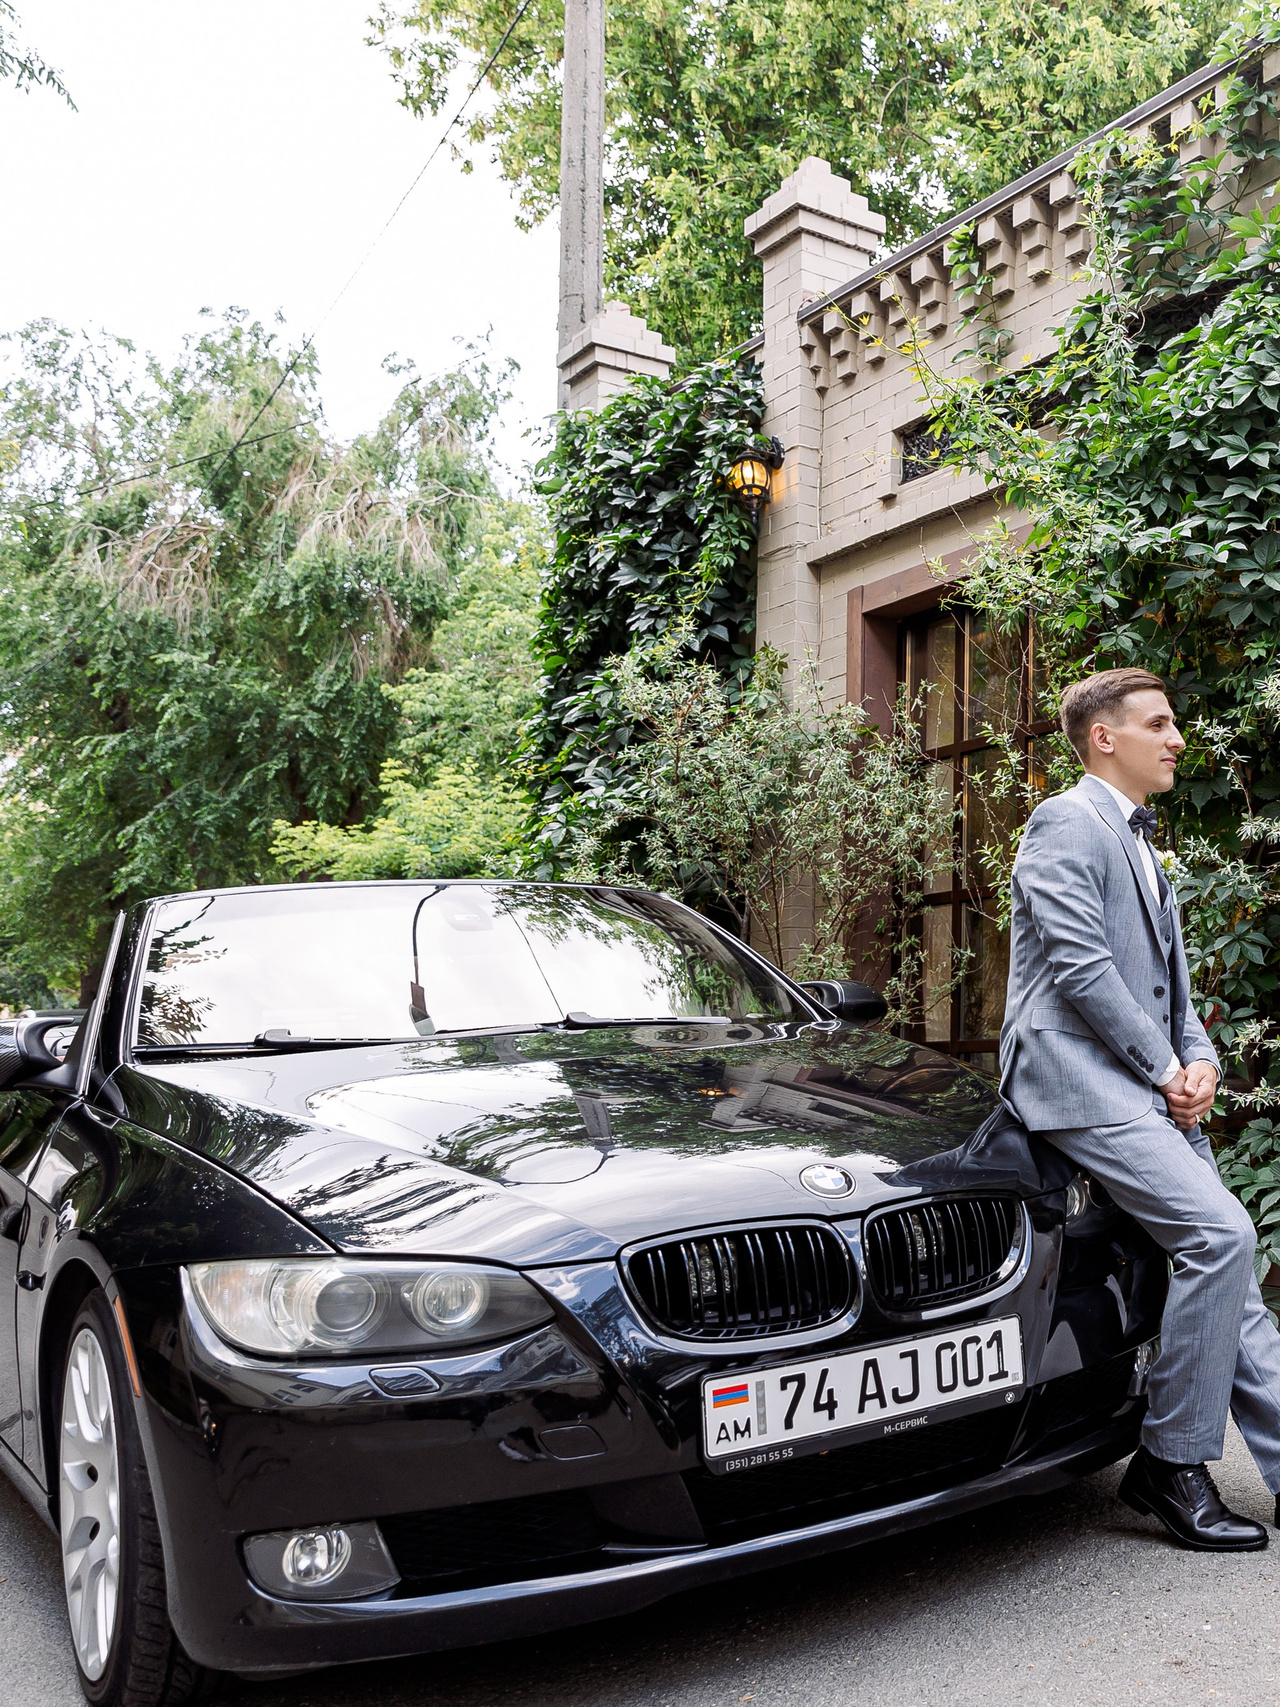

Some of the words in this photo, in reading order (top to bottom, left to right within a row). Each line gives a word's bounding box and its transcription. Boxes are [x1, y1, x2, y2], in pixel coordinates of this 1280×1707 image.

[779, 1367, 838, 1430] 74
[857, 1348, 920, 1414] AJ
[935, 1329, 1009, 1394] 001
[715, 1416, 752, 1445] AM
[883, 1415, 928, 1434] М-СЕРВИС
[725, 1457, 749, 1471] (351)
[750, 1453, 767, 1465] 281
[768, 1450, 780, 1461] 55
[782, 1447, 794, 1458] 55
